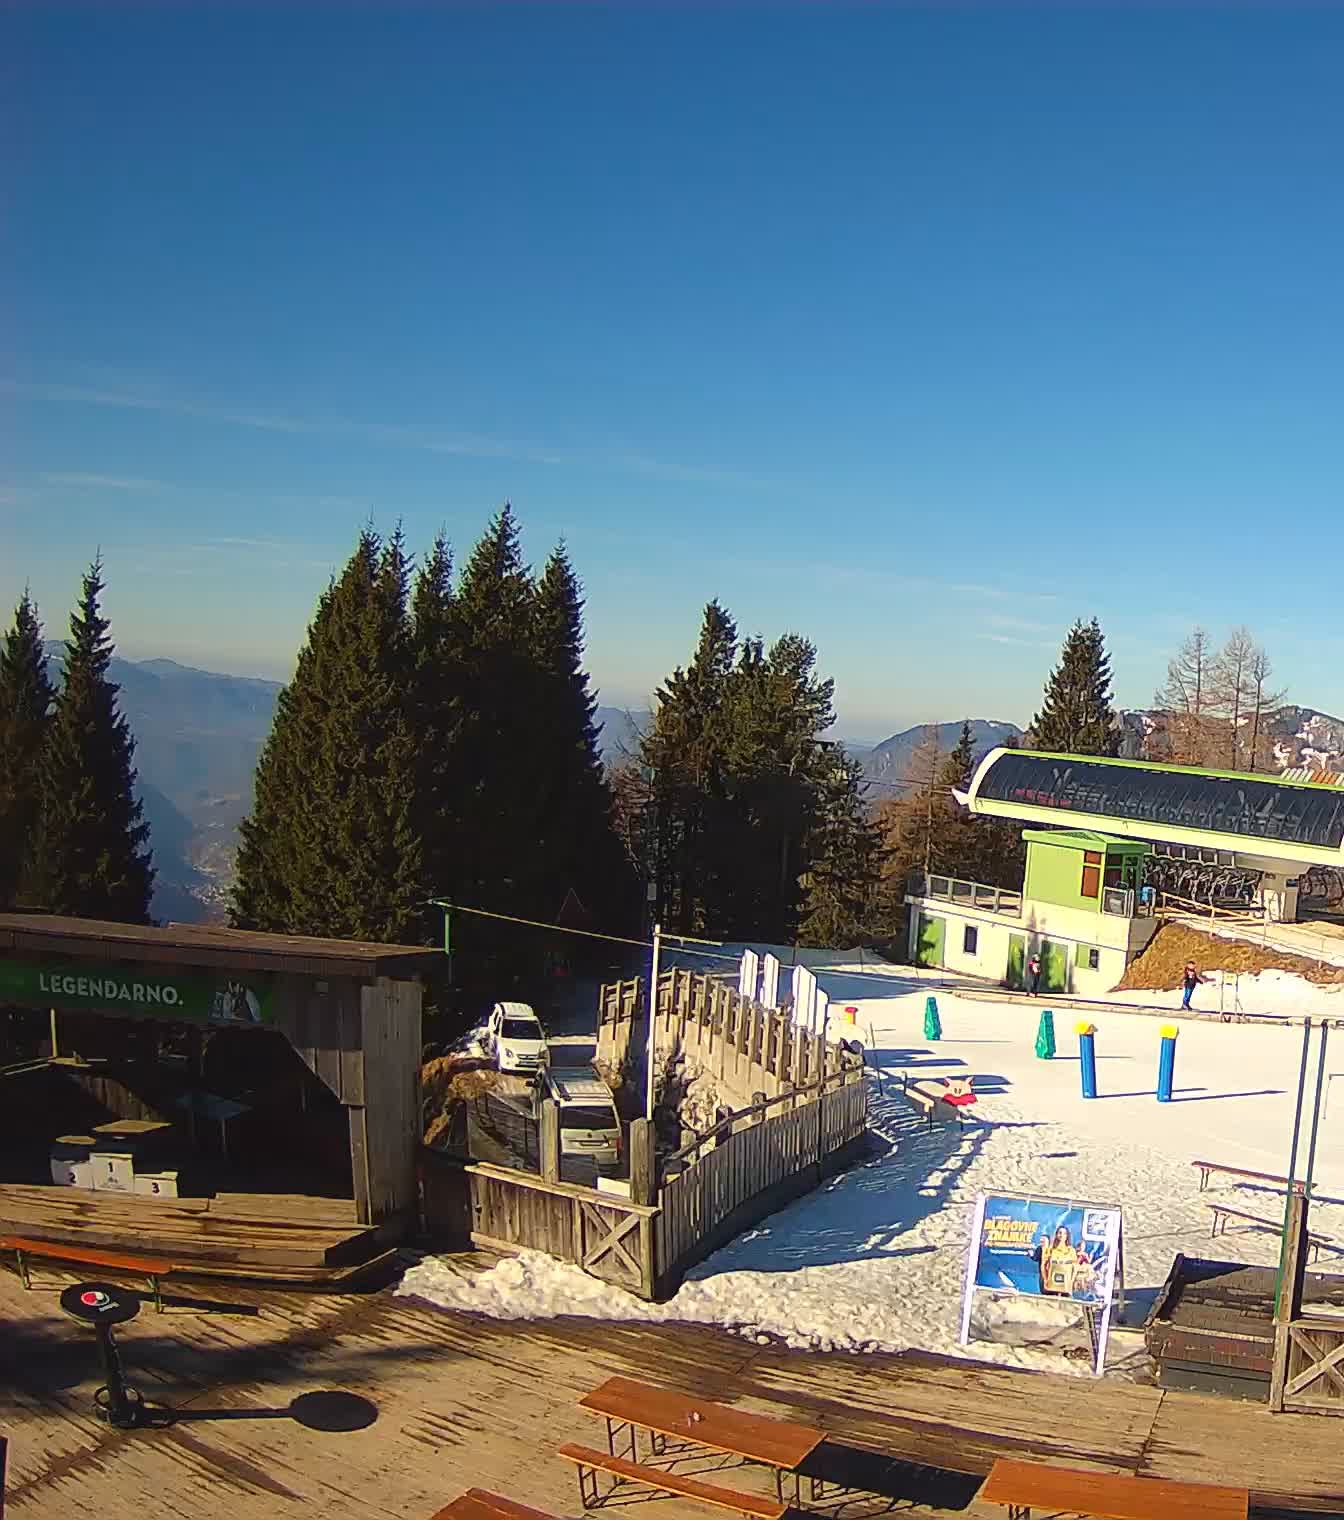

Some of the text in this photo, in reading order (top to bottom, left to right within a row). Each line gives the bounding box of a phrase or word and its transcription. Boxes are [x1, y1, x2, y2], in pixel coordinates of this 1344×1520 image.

[39, 973, 184, 1005] LEGENDARNO.
[108, 1161, 114, 1172] 1
[151, 1182, 160, 1194] 3
